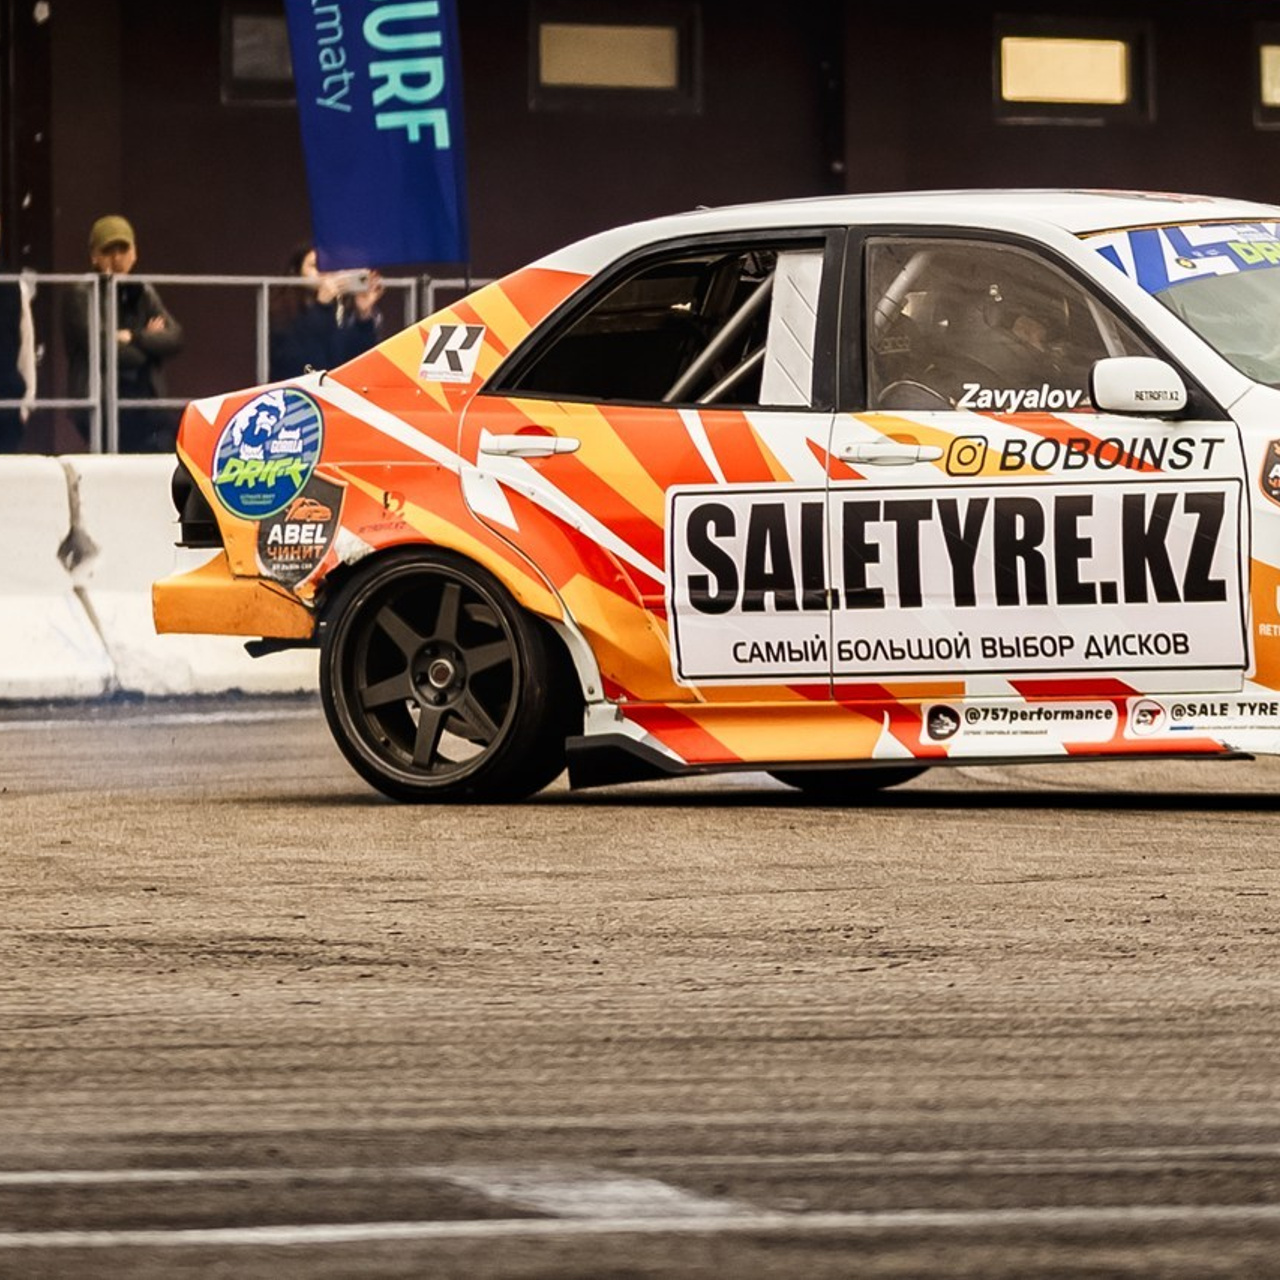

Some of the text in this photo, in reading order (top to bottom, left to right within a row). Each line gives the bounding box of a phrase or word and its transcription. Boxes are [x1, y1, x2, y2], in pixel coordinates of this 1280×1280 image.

[957, 383, 1082, 414] Zavyalov
[999, 437, 1225, 471] BOBOINST
[216, 457, 309, 489] DRIFT
[267, 523, 329, 545] ABEL
[267, 544, 324, 561] ЧИНИТ
[686, 491, 1227, 615] SALETYRE.KZ
[732, 631, 1190, 664] САМЫЙ БОЛЬШОЙ ВЫБОР ДИСКОВ
[964, 707, 1113, 725] @757performance
